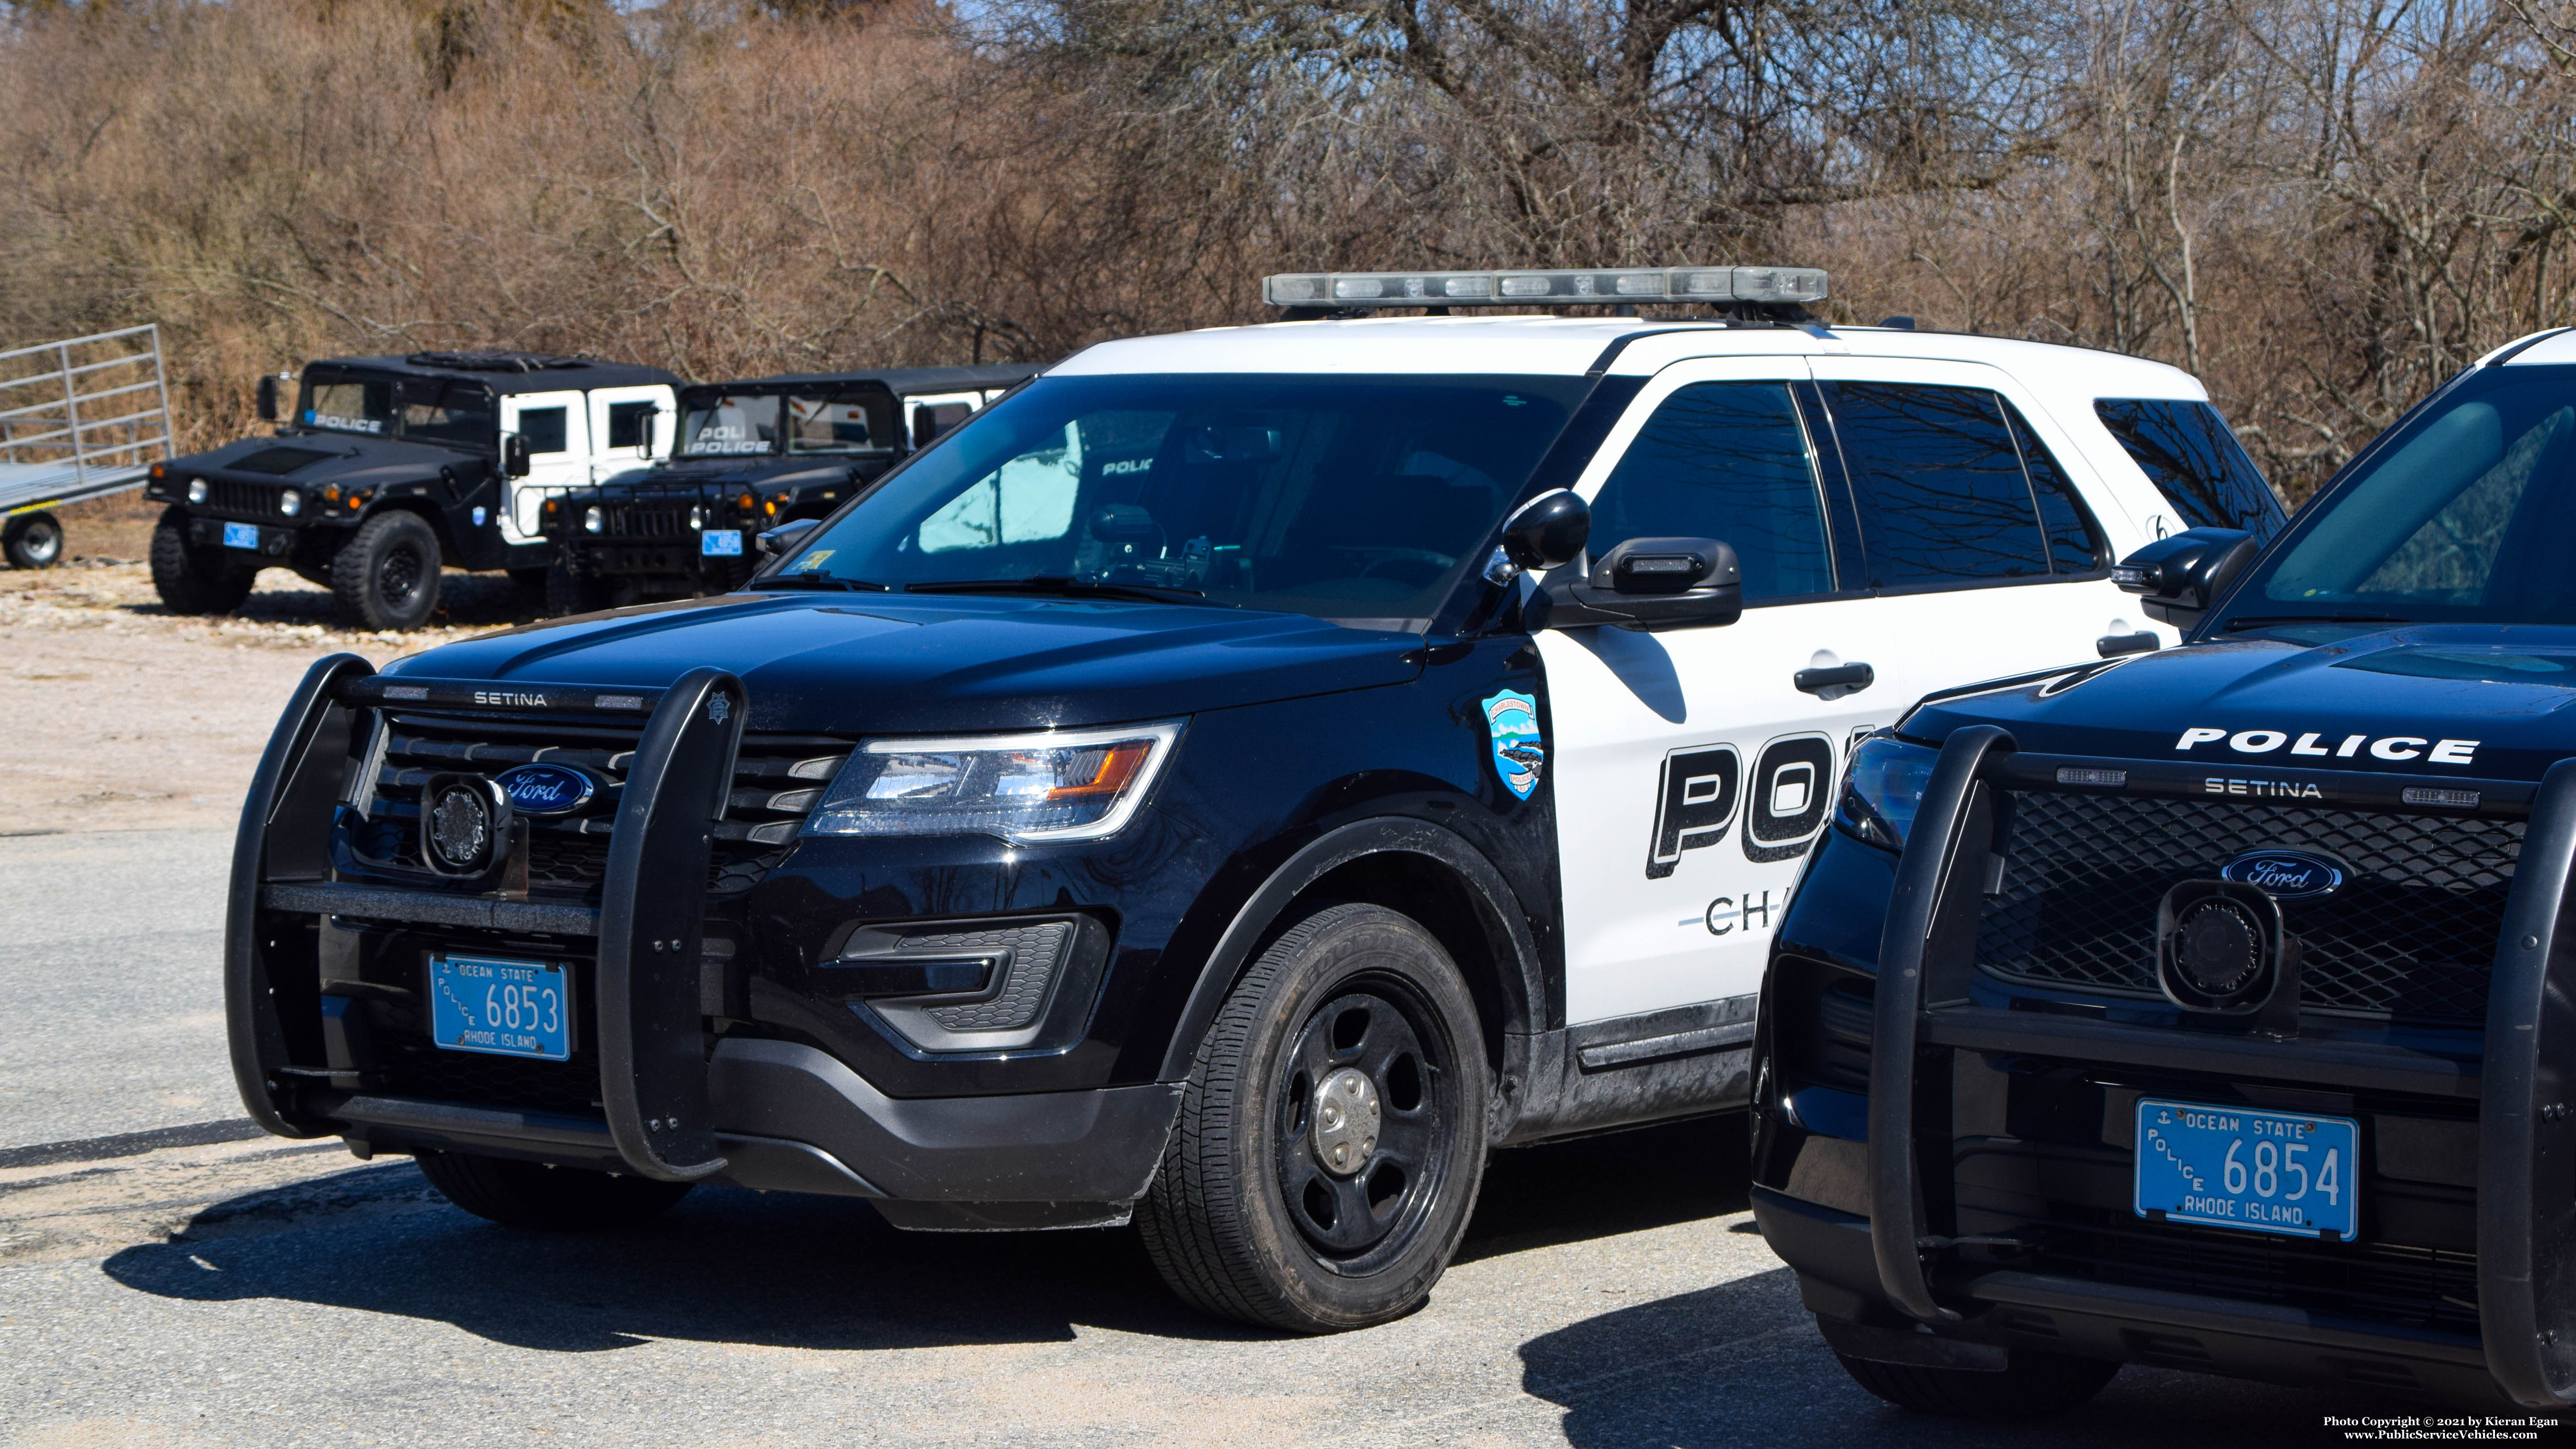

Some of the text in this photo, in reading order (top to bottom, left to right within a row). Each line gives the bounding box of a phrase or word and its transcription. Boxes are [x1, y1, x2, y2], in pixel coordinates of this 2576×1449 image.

[314, 415, 381, 433] POLICE
[690, 440, 771, 455] POLICE
[475, 691, 547, 706] SETINA
[1491, 701, 1529, 716] CHARLESTOWN
[2176, 727, 2480, 764] POLICE
[508, 772, 564, 801] Ford
[2205, 777, 2322, 799] SETINA
[1646, 725, 1875, 879] PO
[2247, 860, 2311, 889] Ford
[1706, 887, 1791, 936] CH
[459, 965, 534, 982] OCEAN STATE
[438, 978, 475, 1026] POLICE
[486, 983, 558, 1033] 6853
[464, 1030, 536, 1049] RHODE ISLAND
[2186, 1113, 2305, 1140] OCEAN STATE
[2148, 1129, 2204, 1192] POLICE
[2224, 1138, 2339, 1206] 6854
[2185, 1195, 2303, 1225] RHODE ISLAND
